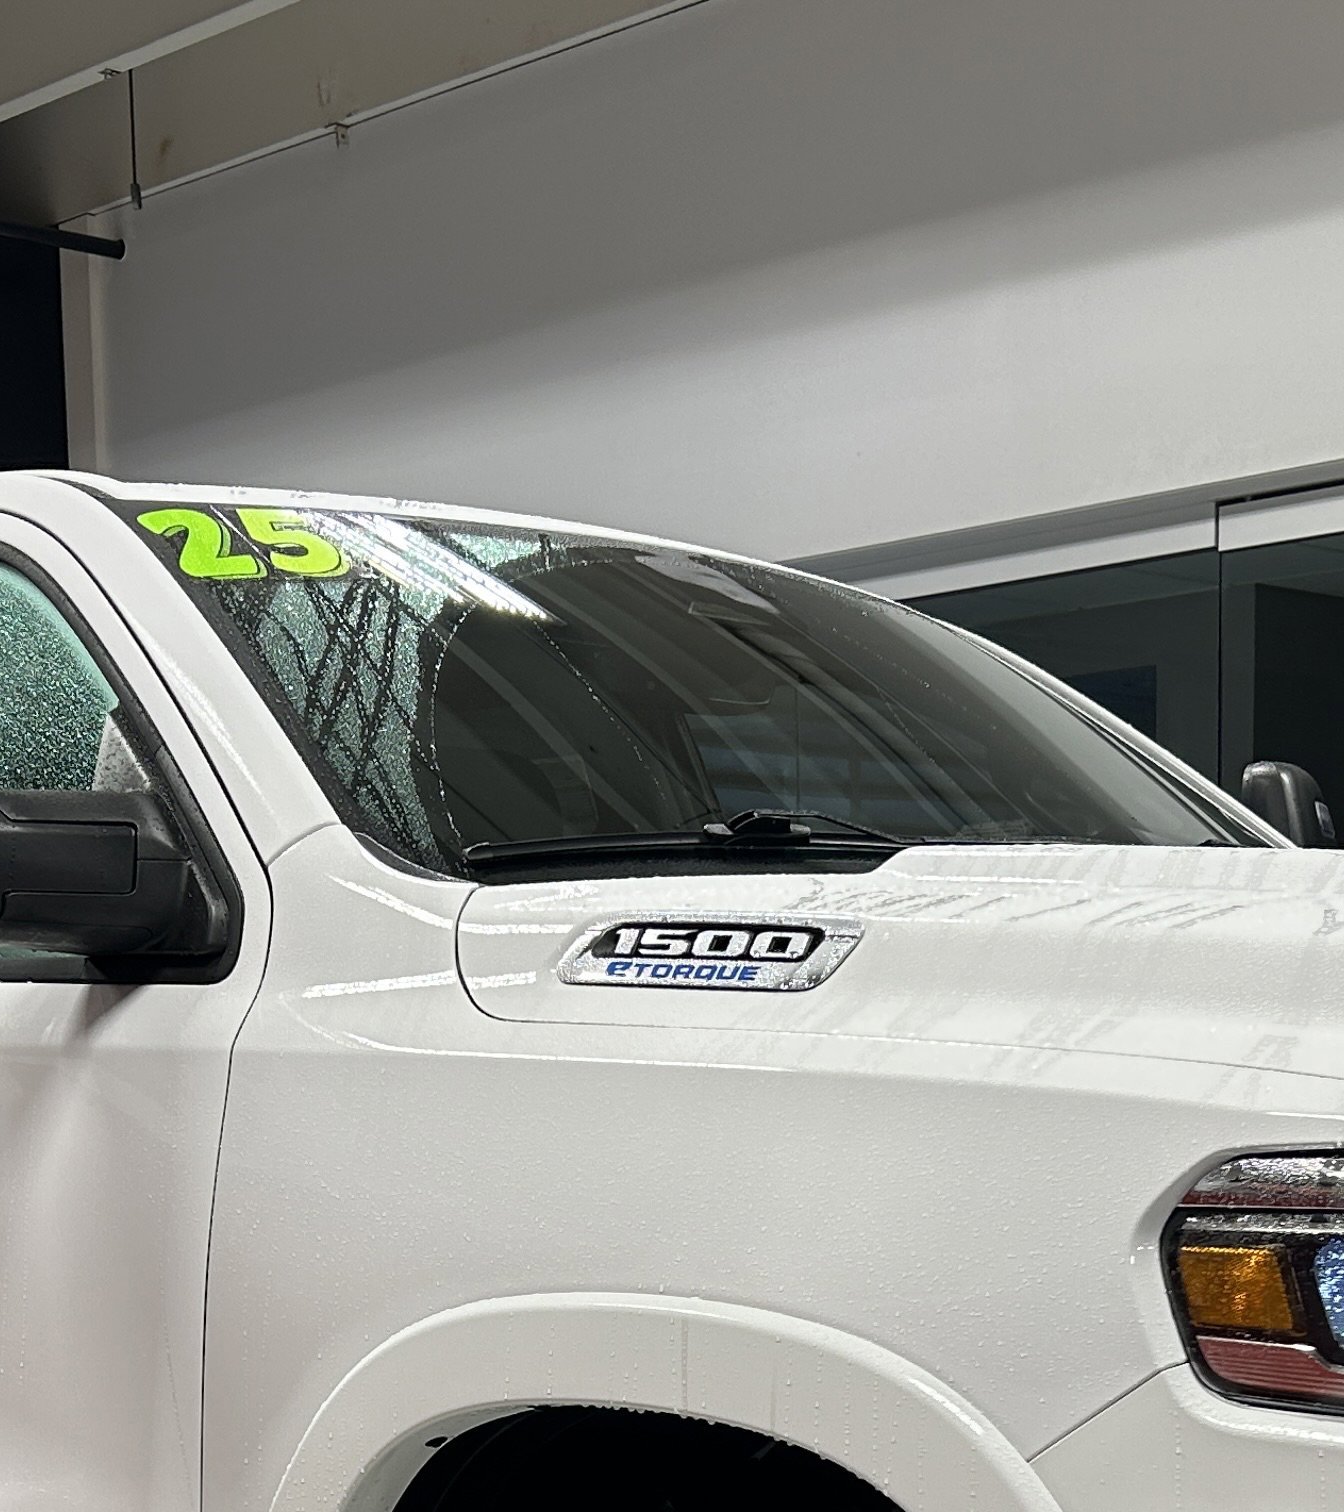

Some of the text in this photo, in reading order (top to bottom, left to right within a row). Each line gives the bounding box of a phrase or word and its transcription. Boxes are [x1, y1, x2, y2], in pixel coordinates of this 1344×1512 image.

[136, 507, 351, 579] 25
[611, 927, 814, 958] 1500
[605, 960, 761, 981] eTORQUE
